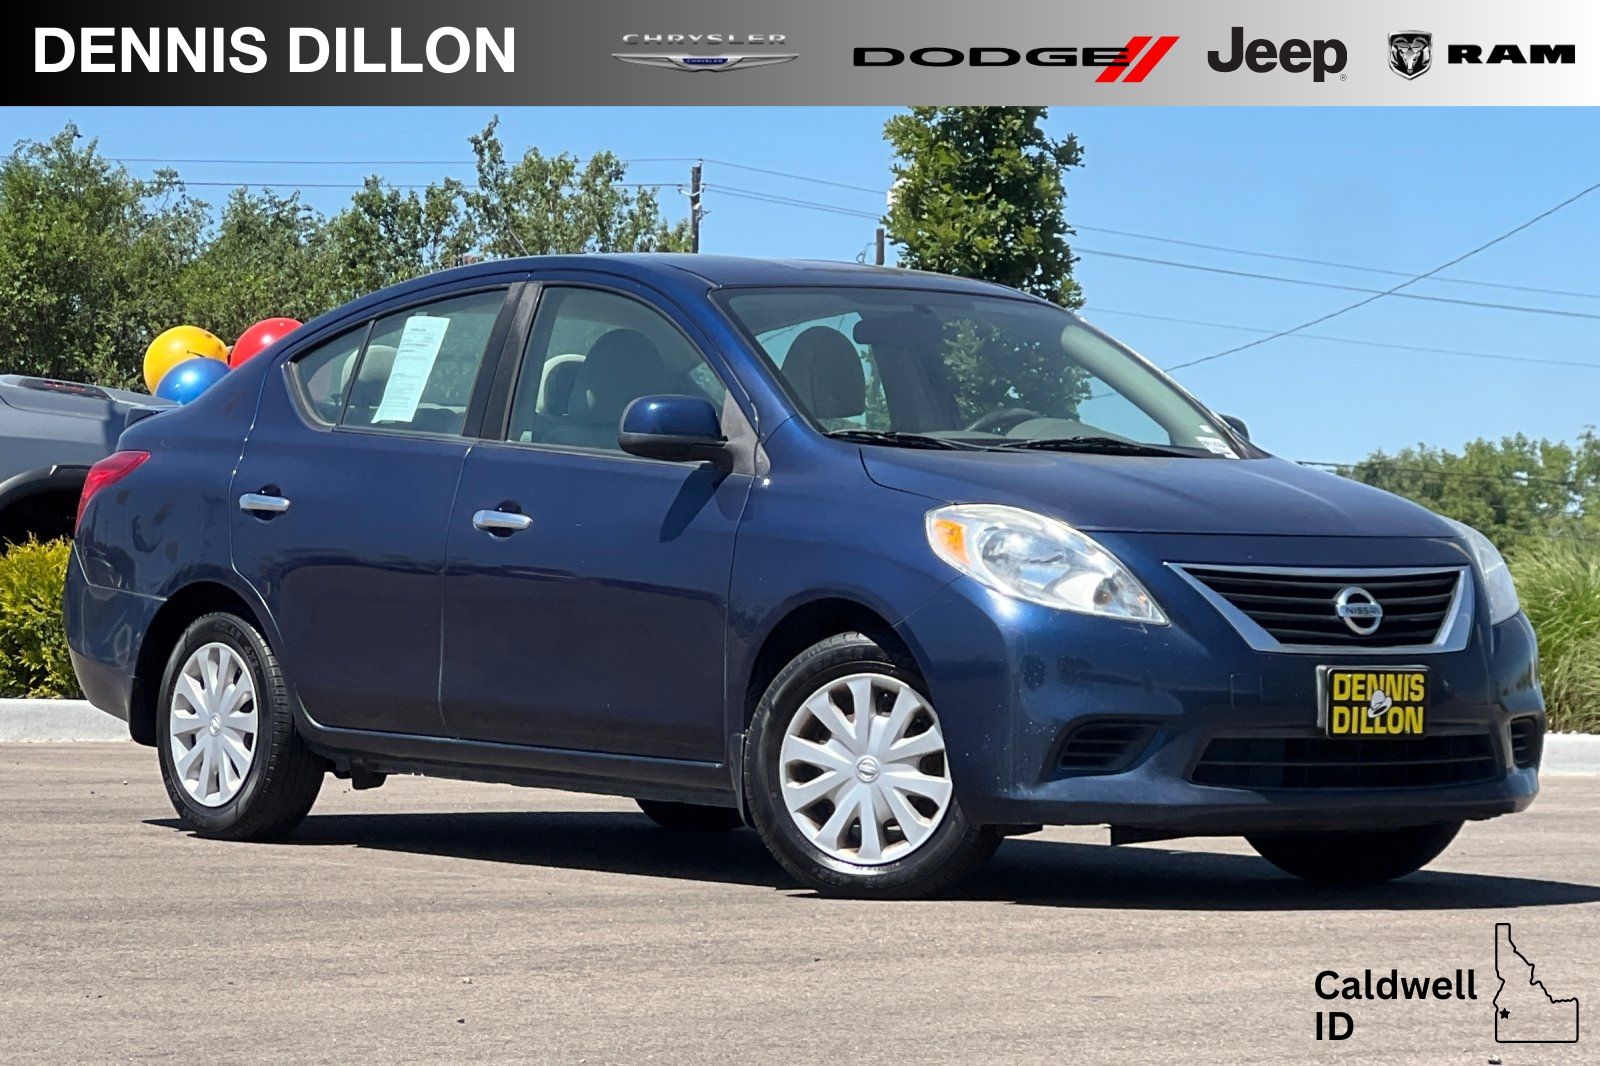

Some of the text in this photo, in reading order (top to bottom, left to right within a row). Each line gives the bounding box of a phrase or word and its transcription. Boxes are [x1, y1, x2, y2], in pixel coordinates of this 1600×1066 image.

[1345, 606, 1380, 615] NISSAN
[1333, 673, 1425, 702] DENNIS
[1332, 706, 1424, 734] DILLON
